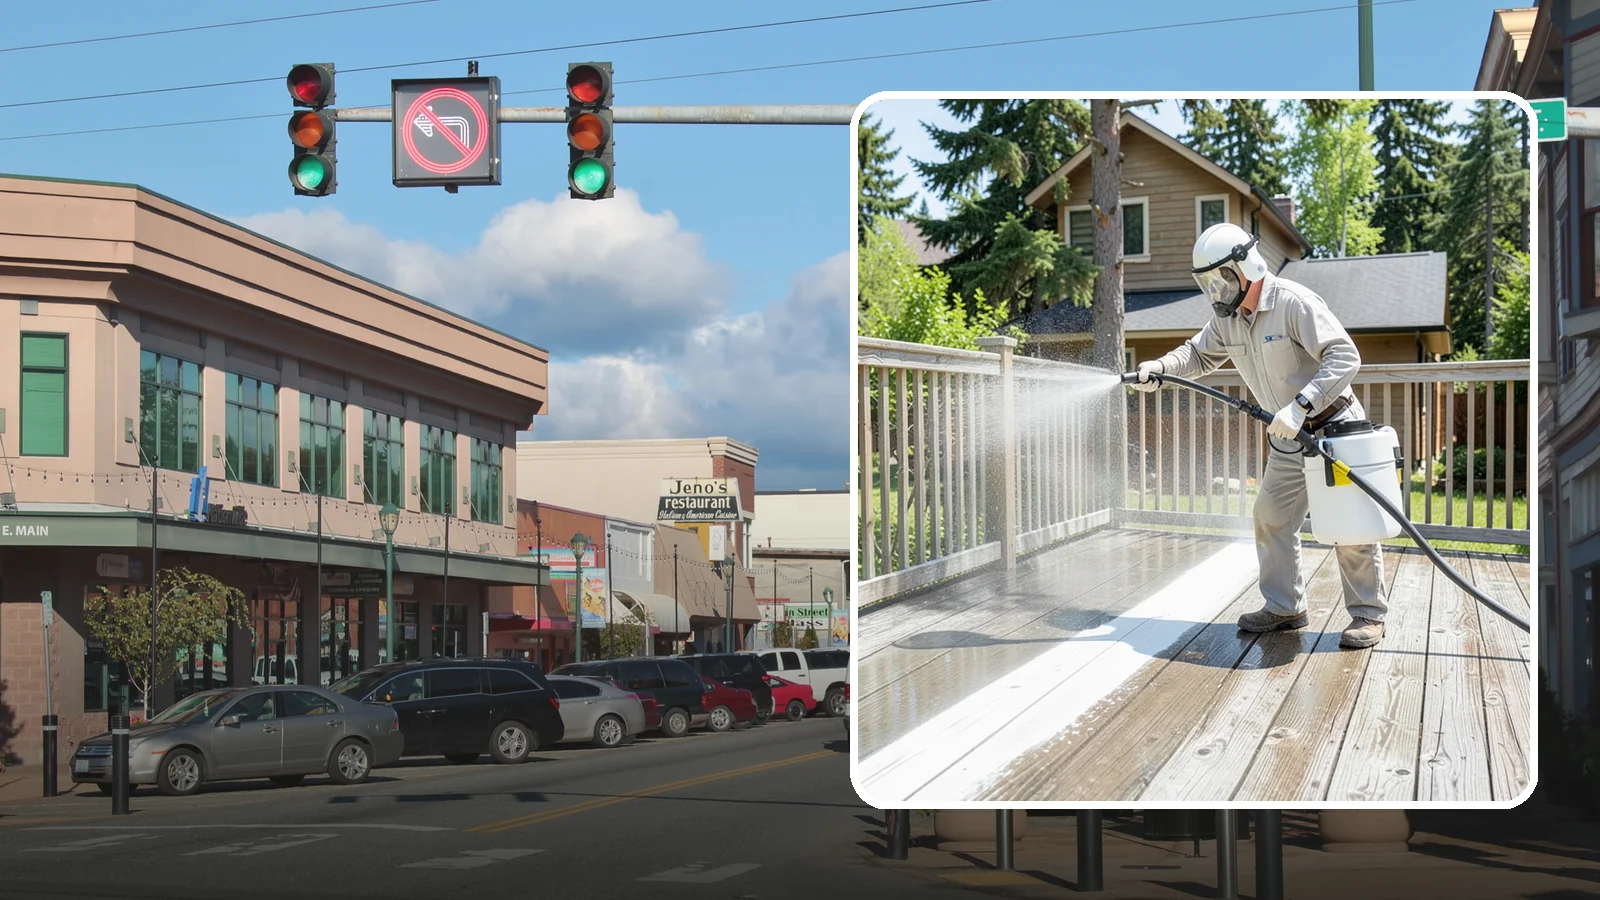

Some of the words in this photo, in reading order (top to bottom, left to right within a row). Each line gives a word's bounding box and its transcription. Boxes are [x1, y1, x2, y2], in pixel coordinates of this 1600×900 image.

[670, 480, 727, 494] Jeno's
[665, 496, 731, 509] restaurant
[686, 510, 714, 519] American
[715, 510, 737, 519] Cuisine
[2, 525, 13, 536] E.
[15, 525, 49, 536] MAIN
[797, 607, 828, 617] Street
